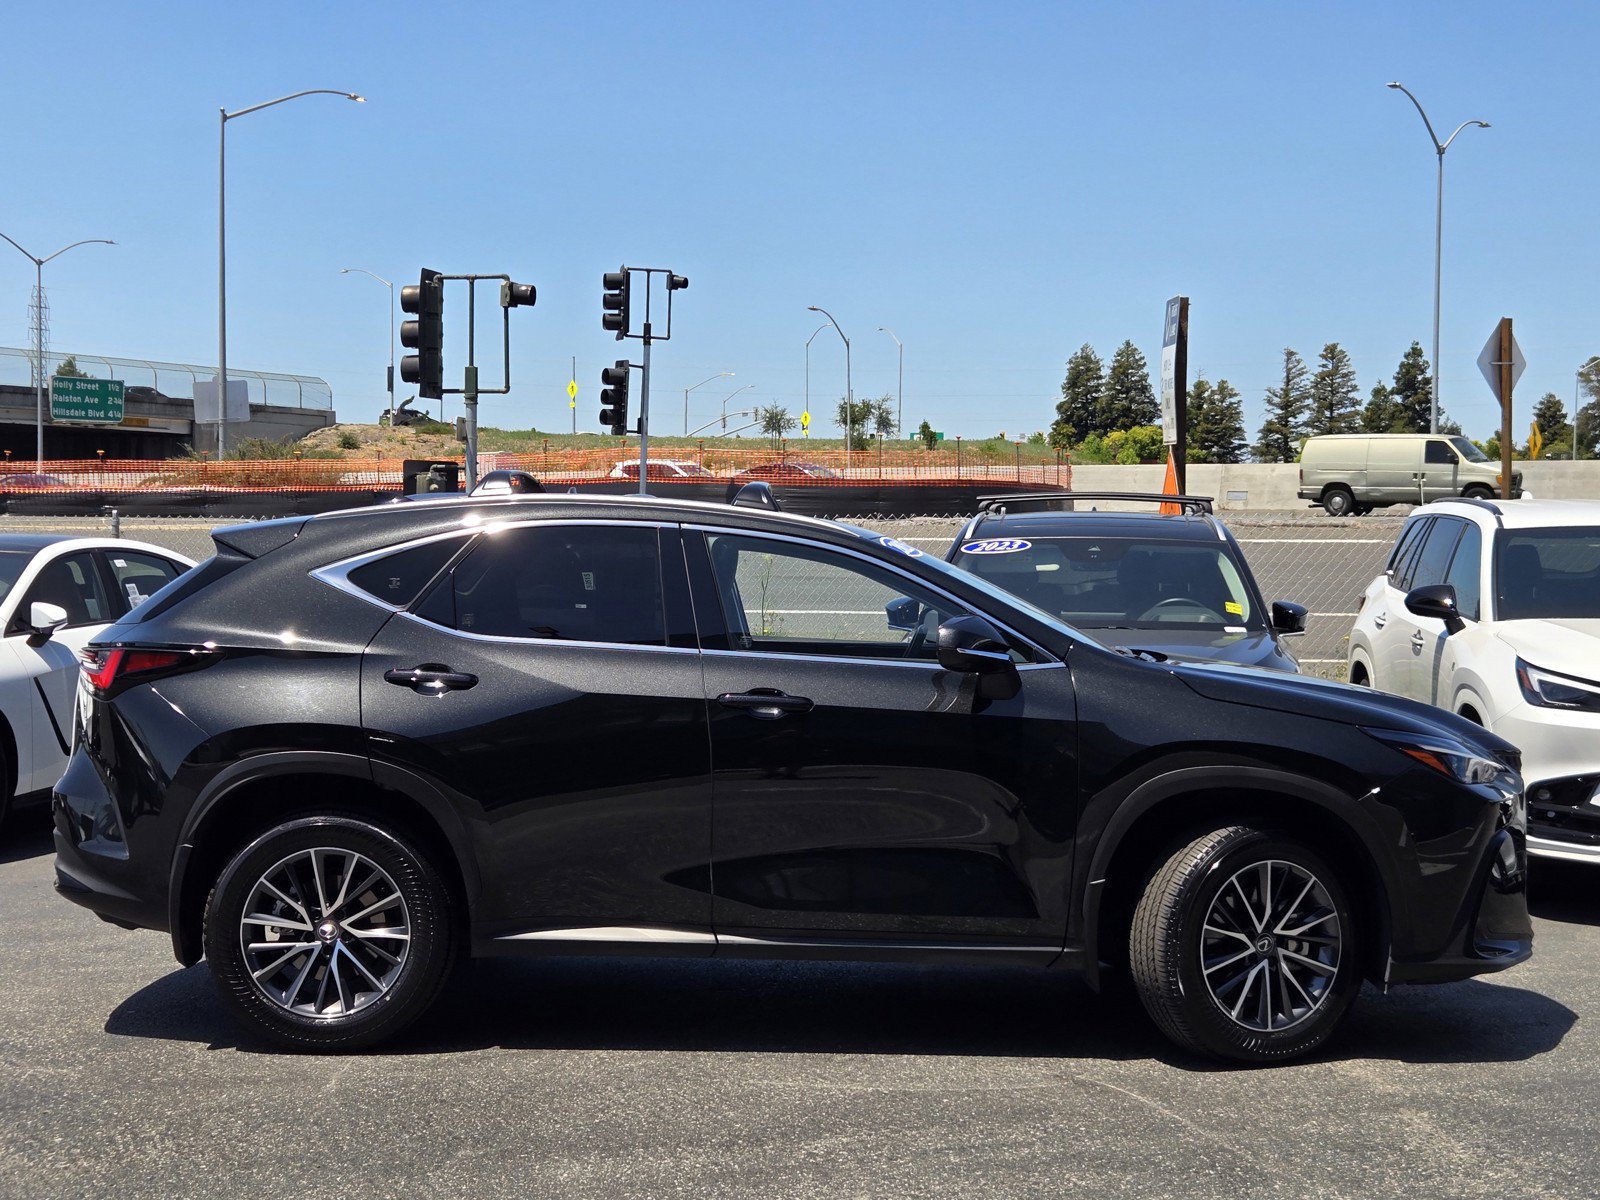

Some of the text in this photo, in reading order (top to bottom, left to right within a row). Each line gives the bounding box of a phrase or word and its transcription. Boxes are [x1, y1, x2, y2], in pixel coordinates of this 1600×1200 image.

[53, 380, 73, 391] Holly
[76, 381, 99, 391] Street
[52, 394, 82, 403] Ralston
[84, 395, 99, 404] Ave
[52, 407, 86, 417] Hillsdale
[87, 409, 105, 418] Blvd
[972, 541, 1021, 552] 2023
